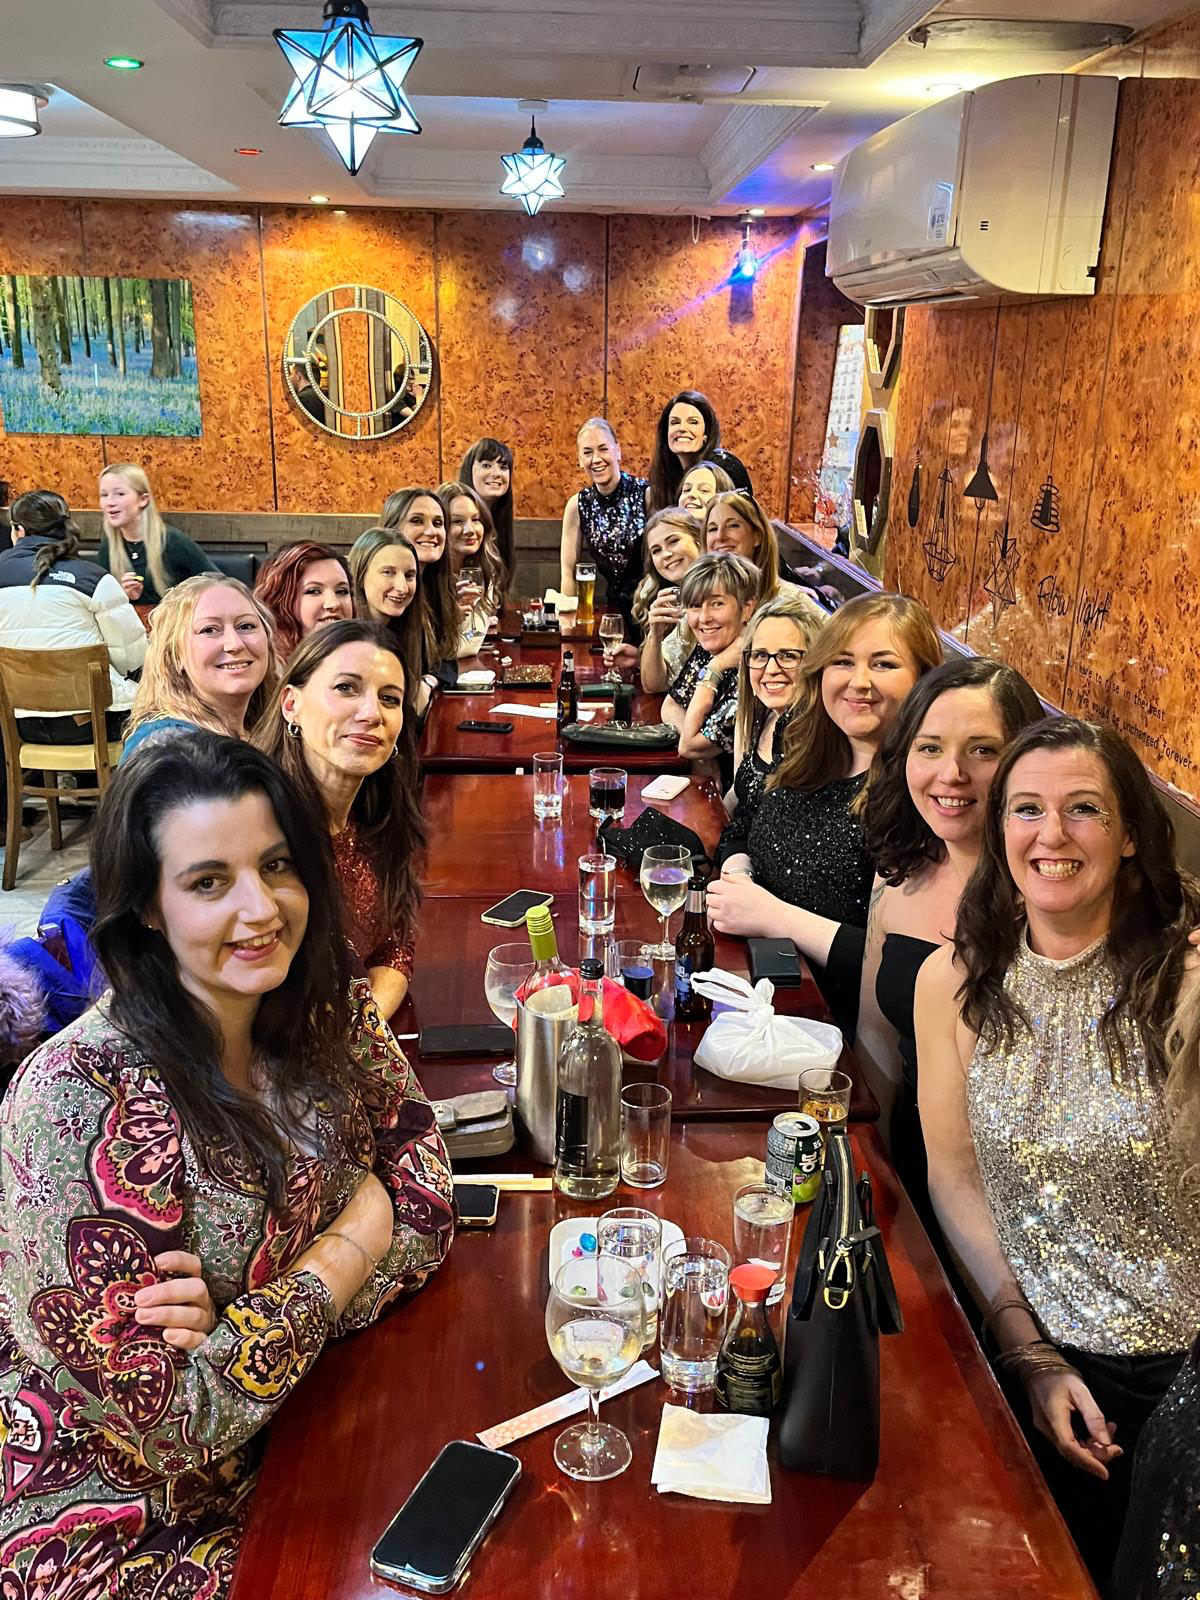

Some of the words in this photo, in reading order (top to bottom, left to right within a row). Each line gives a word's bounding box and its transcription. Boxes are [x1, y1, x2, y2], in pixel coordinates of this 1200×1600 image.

[1037, 575, 1071, 616] Flow
[1076, 585, 1111, 638] light
[1095, 672, 1103, 684] to
[1123, 688, 1131, 701] in
[1134, 694, 1146, 710] the
[1122, 720, 1159, 750] unchanged
[1162, 741, 1193, 769] forever
